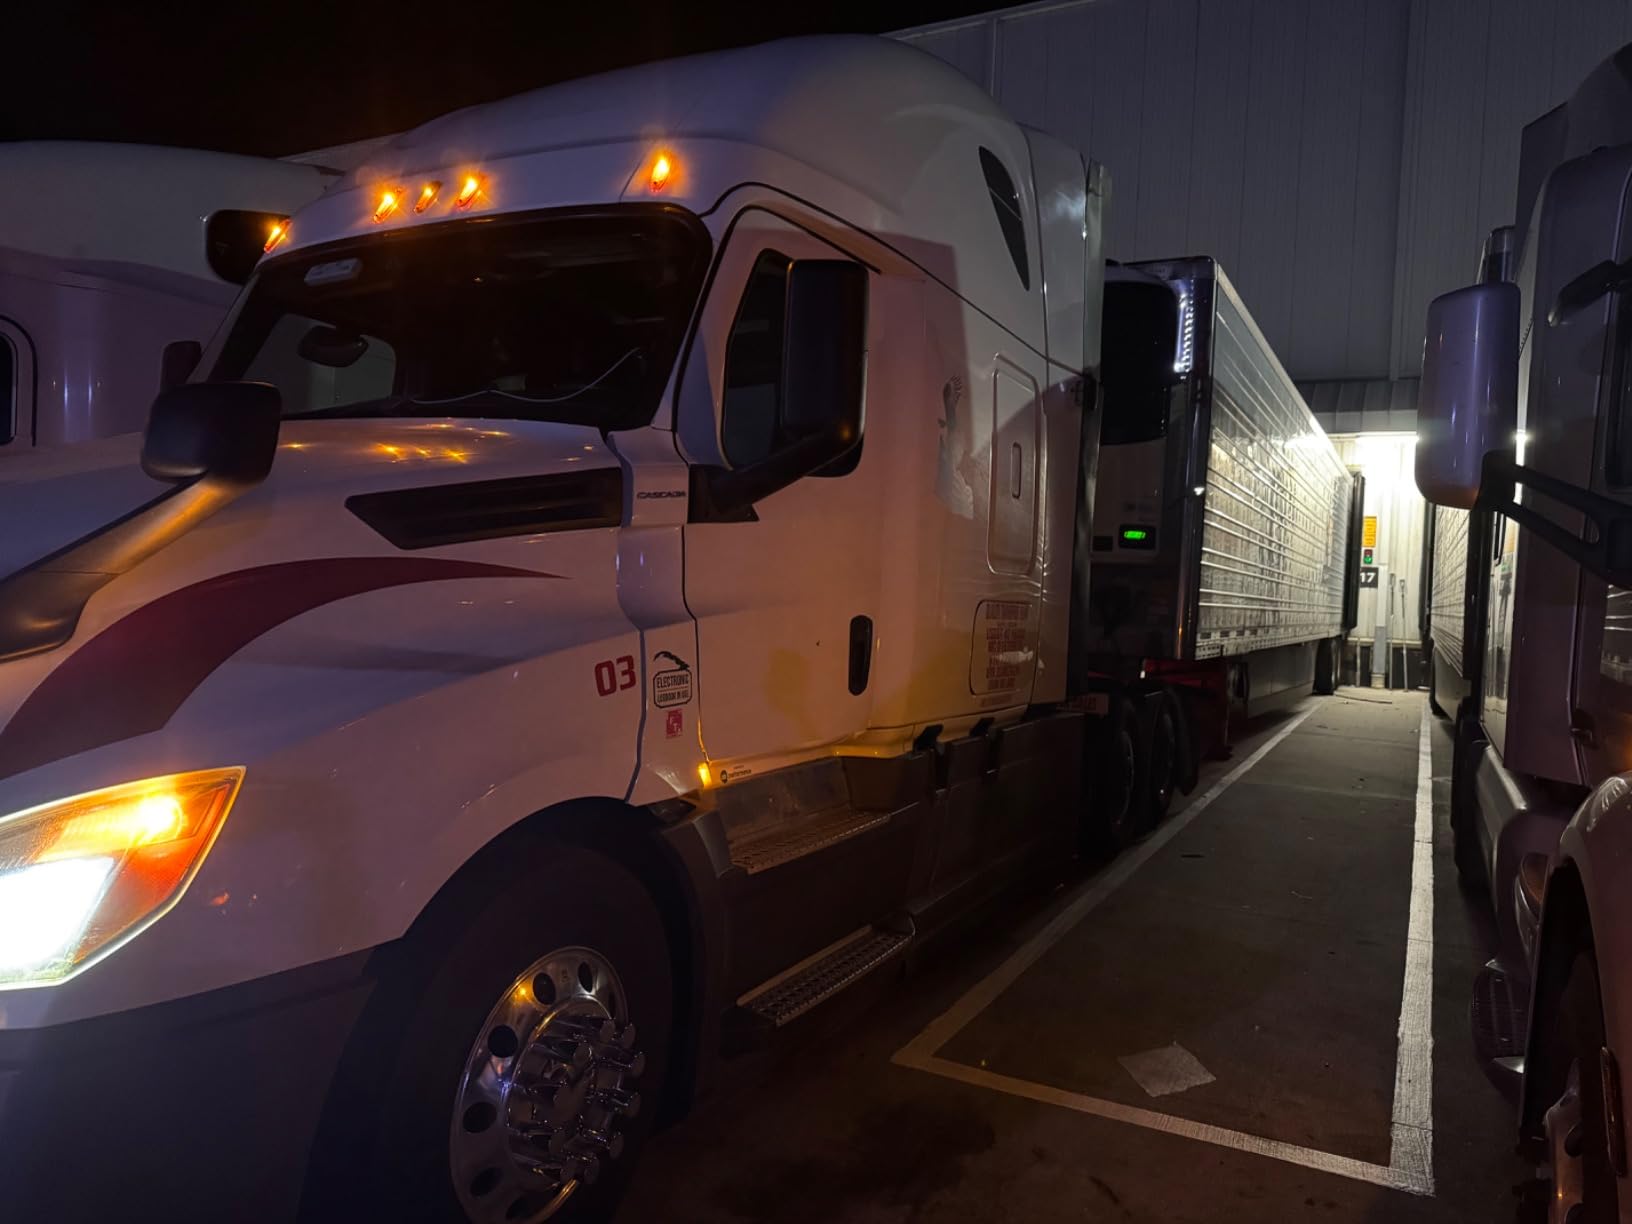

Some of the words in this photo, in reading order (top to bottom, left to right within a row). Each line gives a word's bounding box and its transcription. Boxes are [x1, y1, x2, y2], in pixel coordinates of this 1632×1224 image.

[1360, 572, 1376, 583] 17
[594, 655, 636, 696] 03
[657, 674, 688, 688] ELECTRONIC
